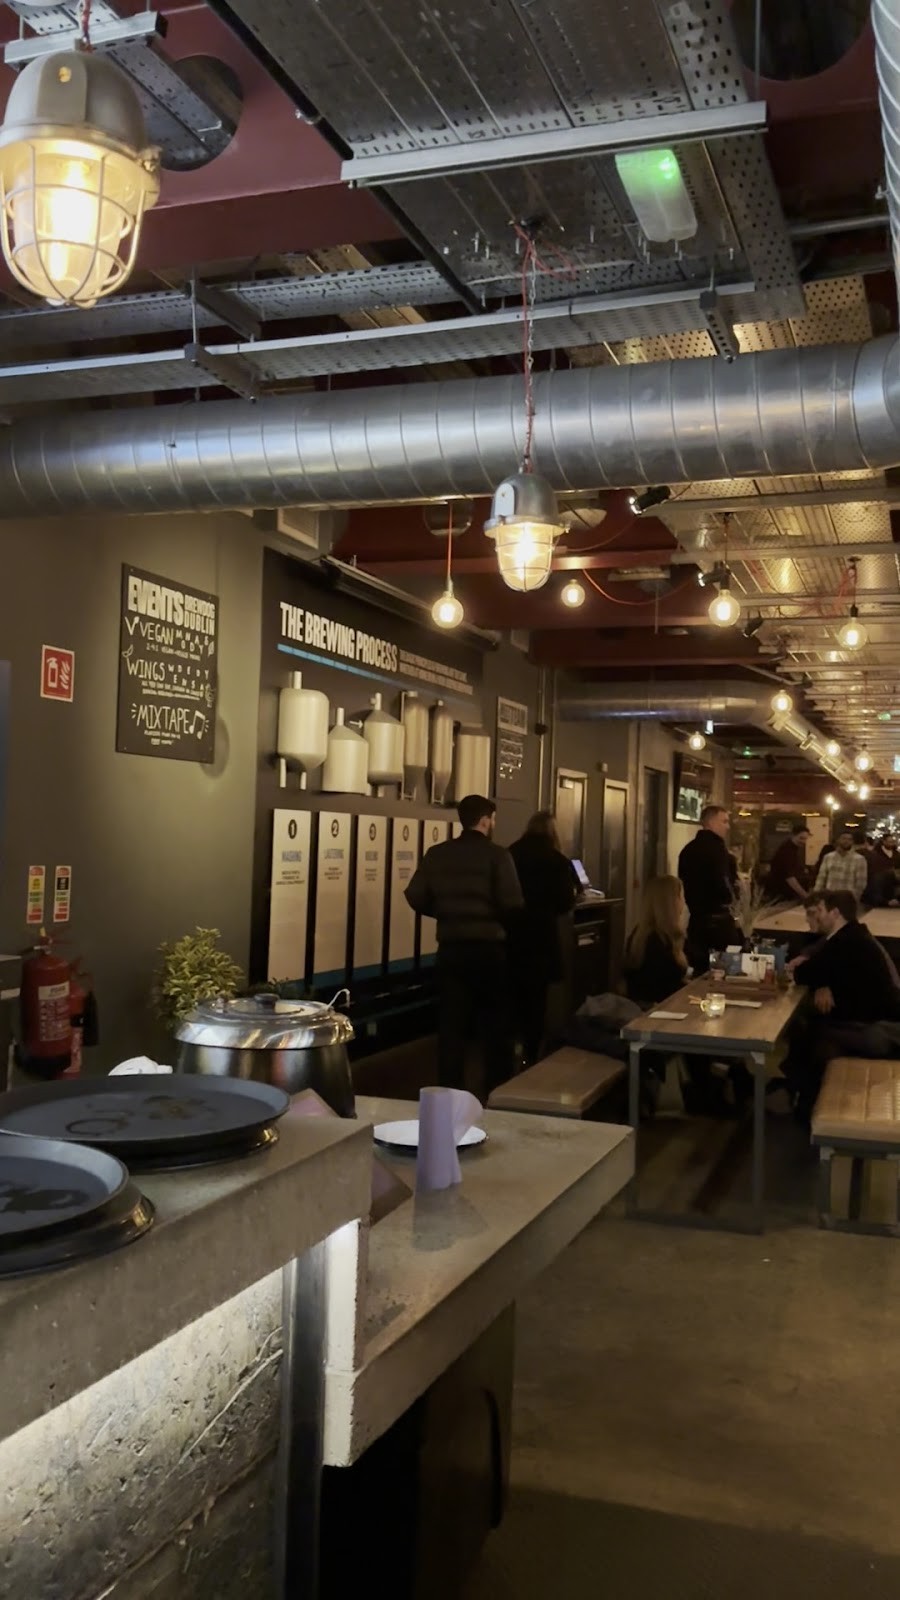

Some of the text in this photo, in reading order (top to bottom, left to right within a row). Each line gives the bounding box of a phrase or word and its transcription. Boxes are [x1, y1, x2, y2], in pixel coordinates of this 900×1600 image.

[128, 575, 184, 626] EVENTS
[140, 621, 174, 646] VEGAN
[184, 610, 215, 636] DUBLIN
[280, 601, 304, 642] THE
[304, 611, 355, 659] BREWING
[355, 630, 398, 672] PROCESS
[126, 657, 166, 682] WINGS
[136, 704, 191, 735] MIXTAPE
